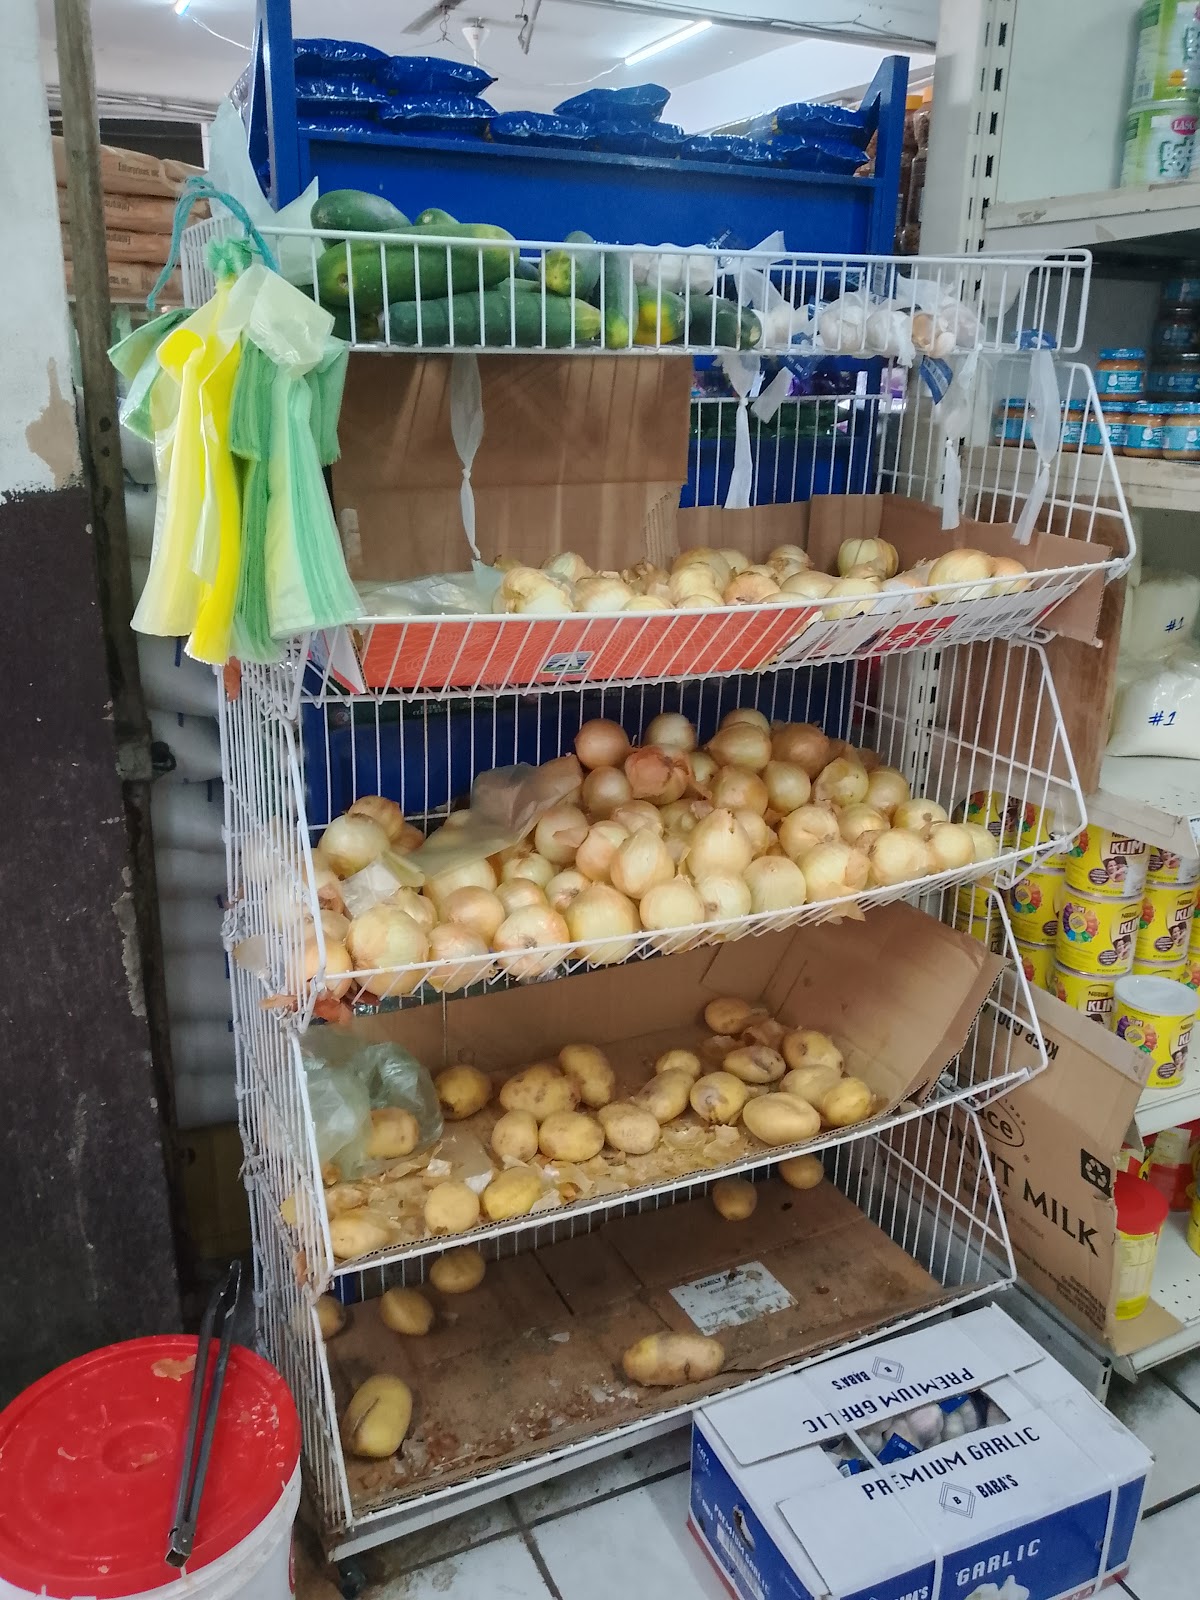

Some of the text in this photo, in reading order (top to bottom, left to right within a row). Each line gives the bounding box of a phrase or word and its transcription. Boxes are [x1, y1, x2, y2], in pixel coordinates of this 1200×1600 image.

[1164, 616, 1185, 633] #1
[1147, 710, 1178, 726] #1
[1111, 840, 1145, 855] KLIM
[1022, 1178, 1100, 1257] MILK
[831, 1370, 871, 1391] BABA'S
[878, 1367, 976, 1409] PREMIUM
[860, 1426, 1041, 1502] PREMIUM GARLIC
[976, 1473, 1020, 1499] BABA'S
[955, 1539, 1042, 1588] GARLIC
